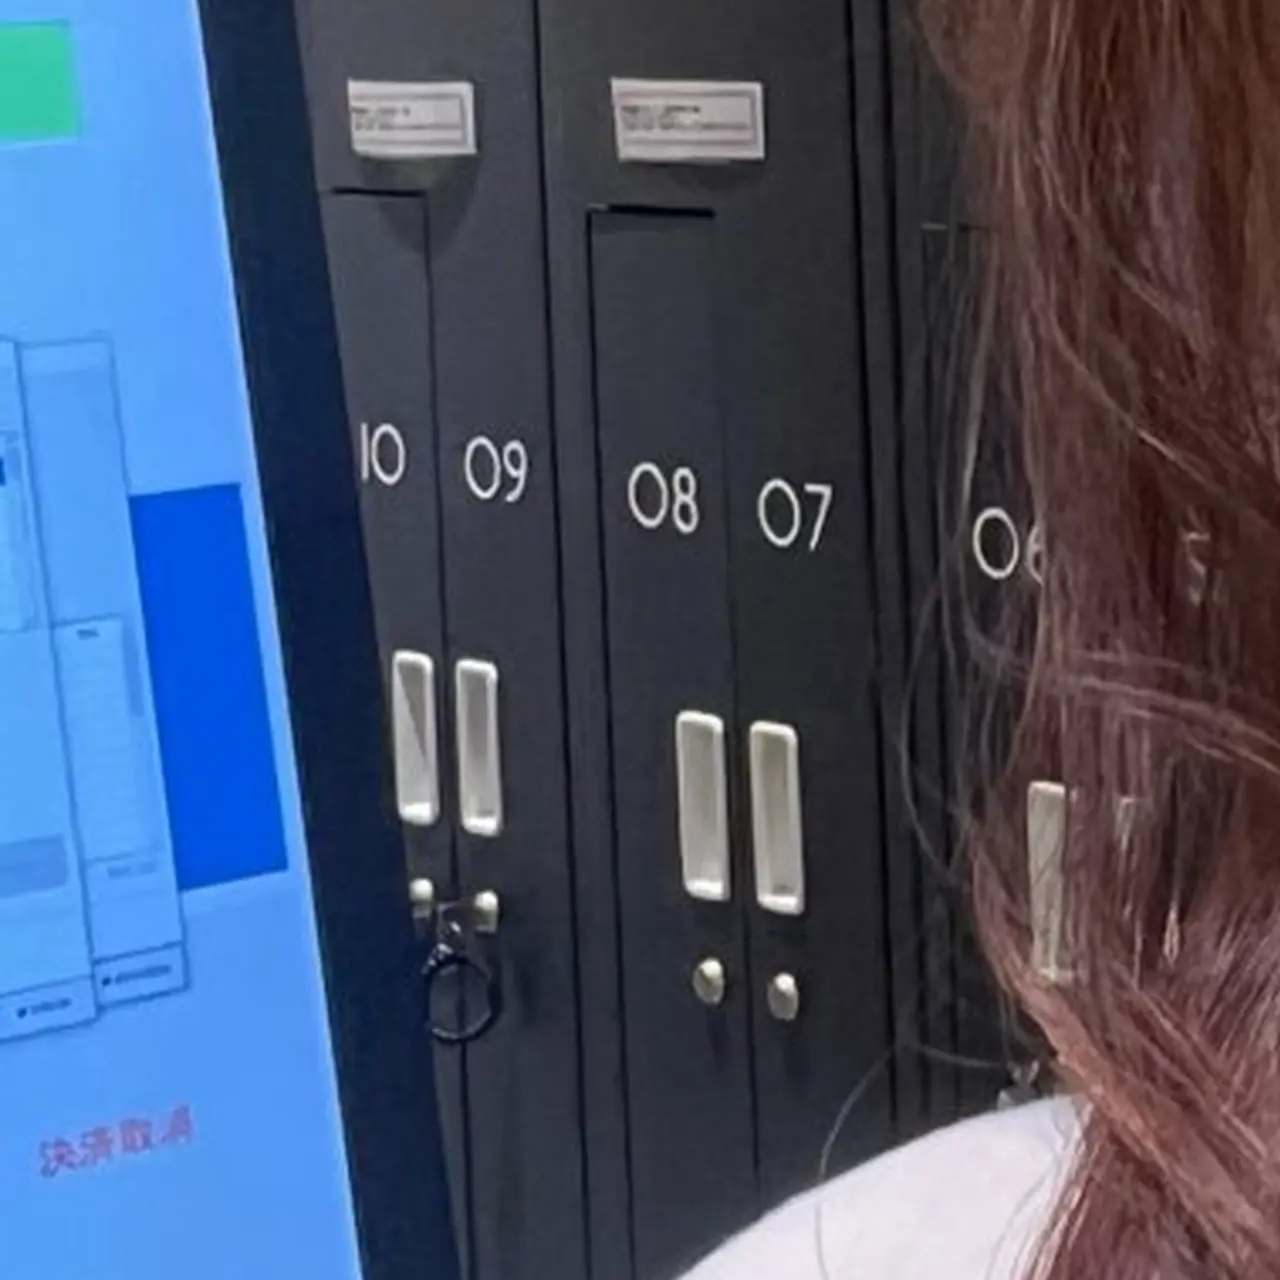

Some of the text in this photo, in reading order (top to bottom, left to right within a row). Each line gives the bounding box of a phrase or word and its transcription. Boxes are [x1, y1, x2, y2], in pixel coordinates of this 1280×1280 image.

[360, 423, 406, 486] 10
[464, 435, 528, 503] 09
[627, 461, 699, 534] 08
[757, 477, 832, 552] 07
